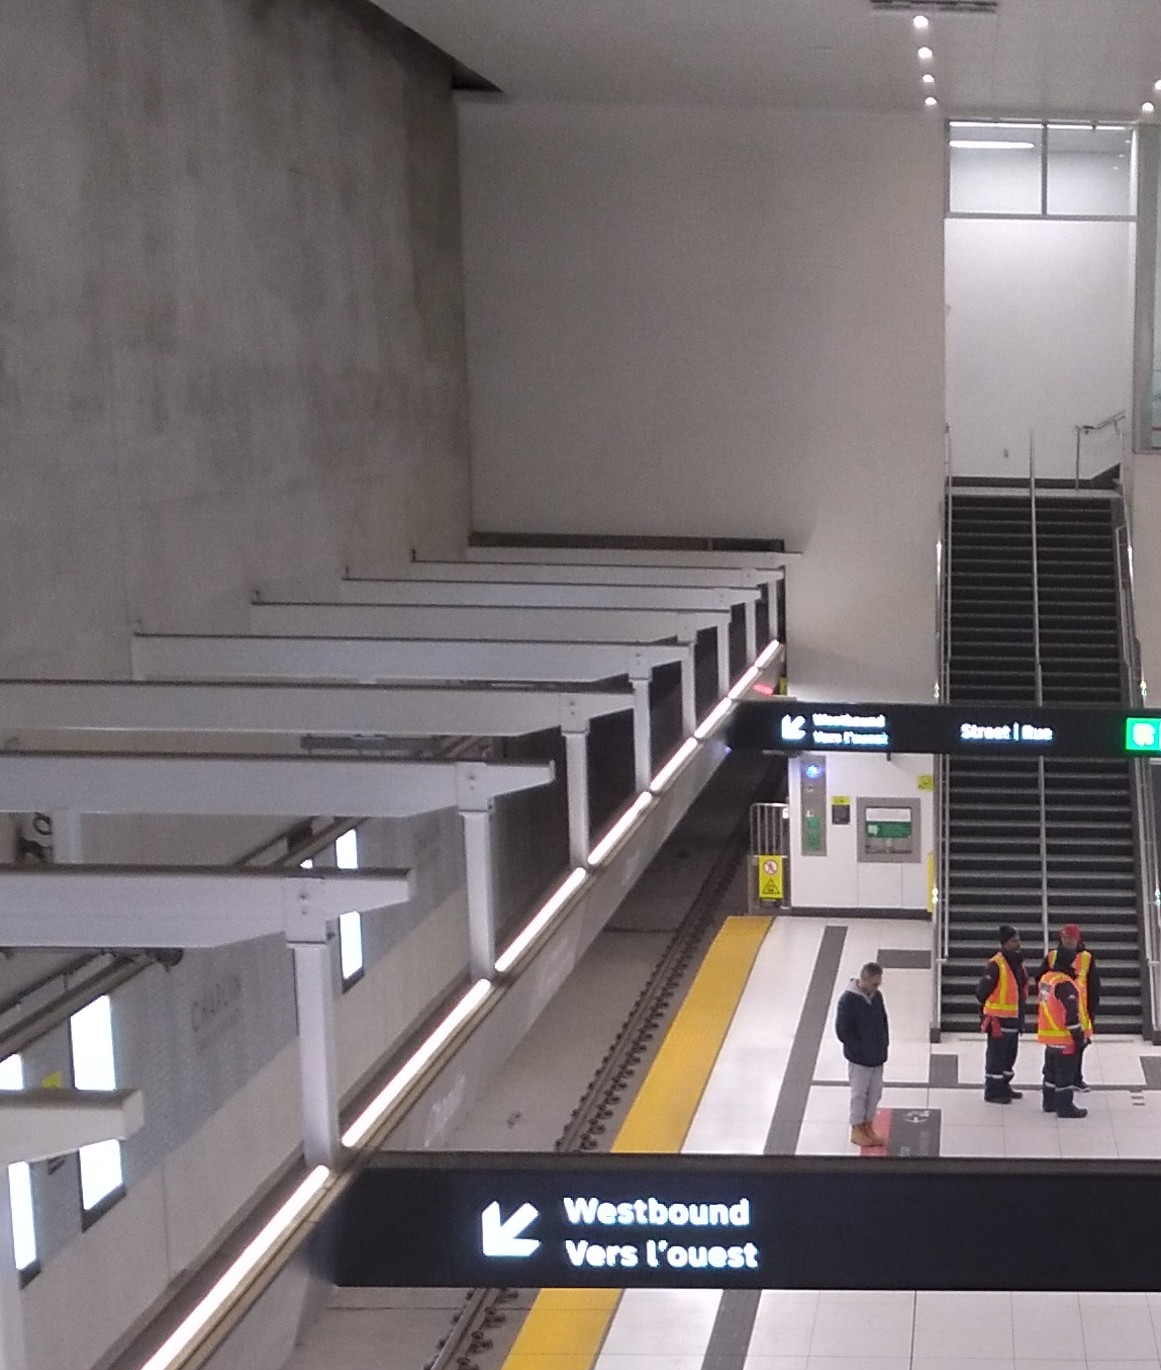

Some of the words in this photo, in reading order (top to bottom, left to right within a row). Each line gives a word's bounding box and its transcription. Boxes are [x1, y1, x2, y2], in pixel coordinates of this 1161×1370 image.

[961, 723, 1010, 740] Street
[1021, 724, 1053, 740] Rue
[563, 1197, 751, 1226] Westbound
[565, 1239, 639, 1268] Vers
[646, 1239, 759, 1268] l'ouest
